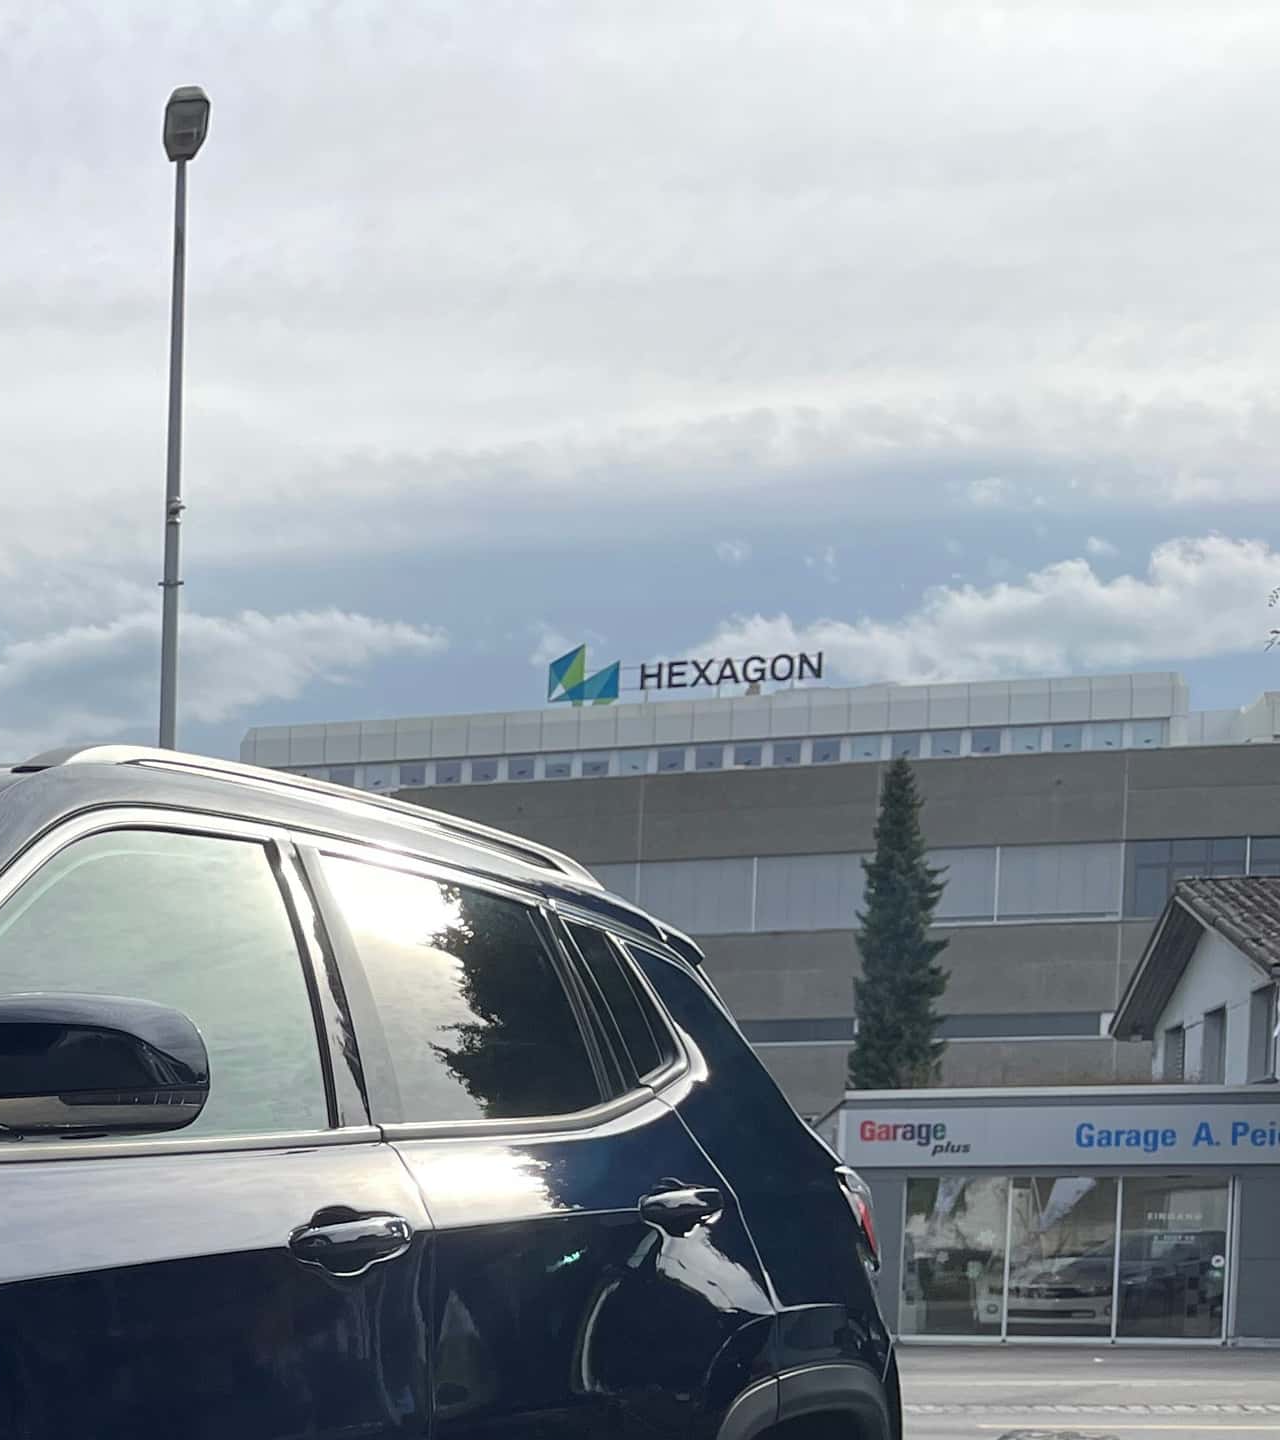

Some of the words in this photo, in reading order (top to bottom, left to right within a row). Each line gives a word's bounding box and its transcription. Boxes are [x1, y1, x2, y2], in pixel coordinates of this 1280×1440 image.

[640, 651, 824, 690] HEXAGON
[860, 1120, 947, 1146] Garage
[1075, 1122, 1177, 1152] Garage
[1192, 1122, 1221, 1147] A.
[931, 1141, 971, 1156] plus
